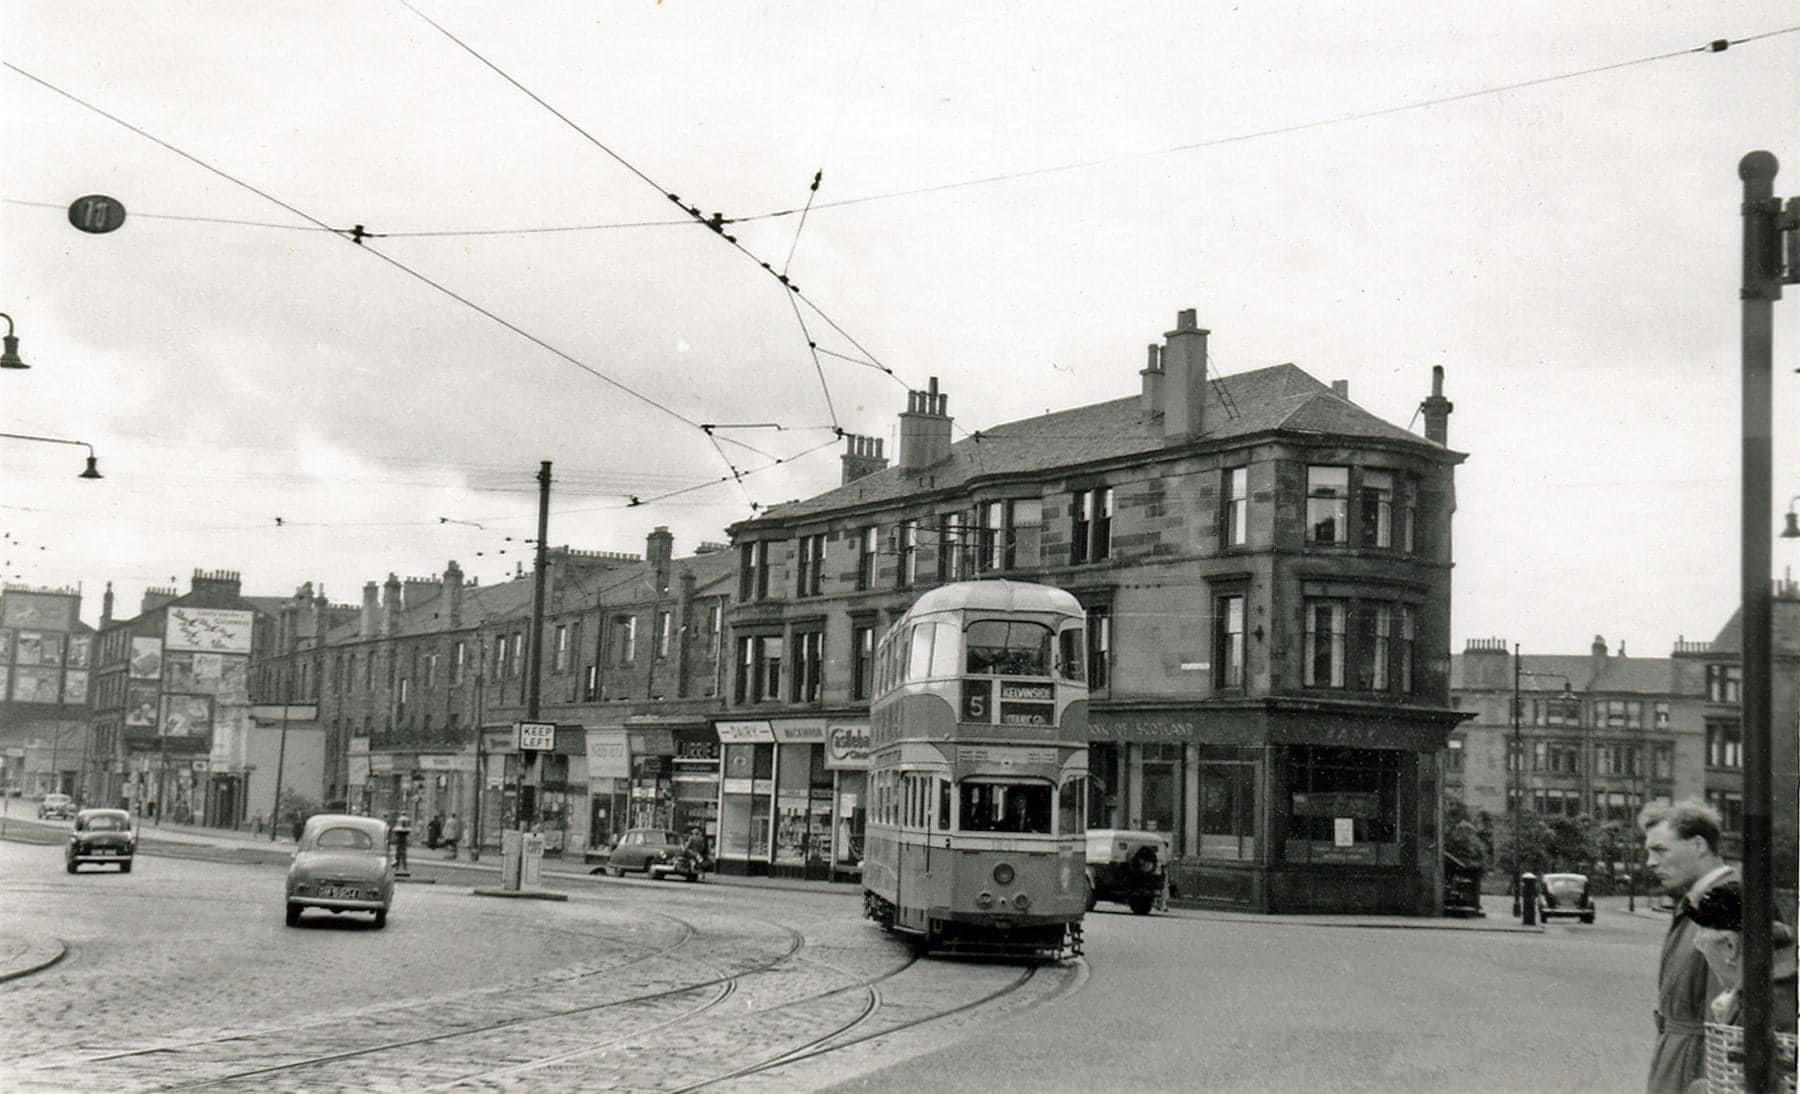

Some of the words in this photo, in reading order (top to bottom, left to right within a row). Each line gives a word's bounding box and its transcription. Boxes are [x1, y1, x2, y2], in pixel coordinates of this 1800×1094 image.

[1003, 687, 1051, 698] KELVINSIDE
[970, 696, 984, 716] 5
[524, 727, 552, 737] KEEP
[1136, 722, 1193, 736] SCOTLAND
[523, 737, 550, 748] LEFT
